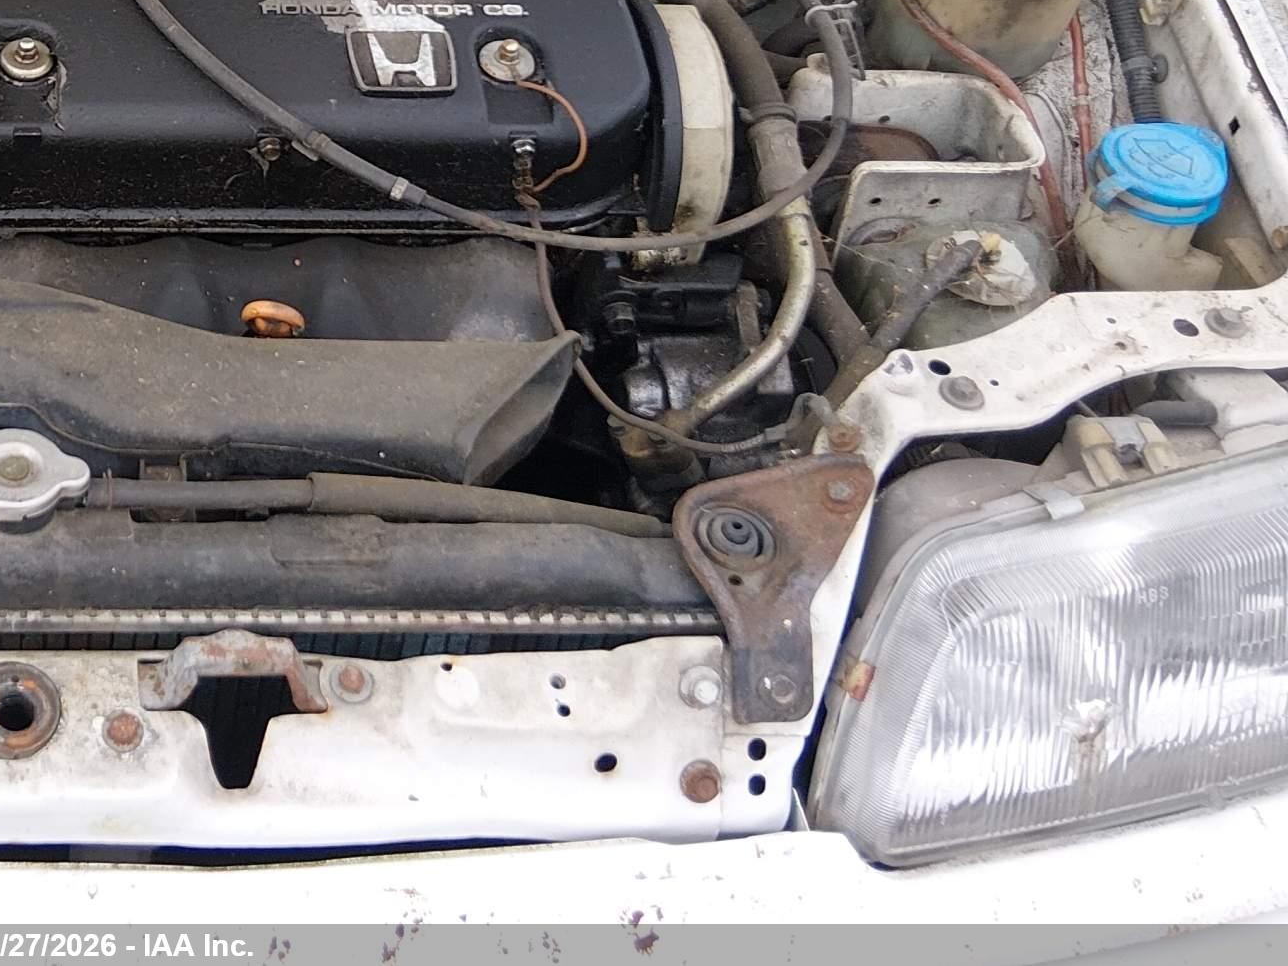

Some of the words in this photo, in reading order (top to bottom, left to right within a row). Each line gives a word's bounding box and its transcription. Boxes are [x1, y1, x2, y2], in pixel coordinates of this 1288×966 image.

[260, 3, 363, 16] HONDA
[371, 3, 474, 17] MOTOR
[481, 3, 530, 17] CO.
